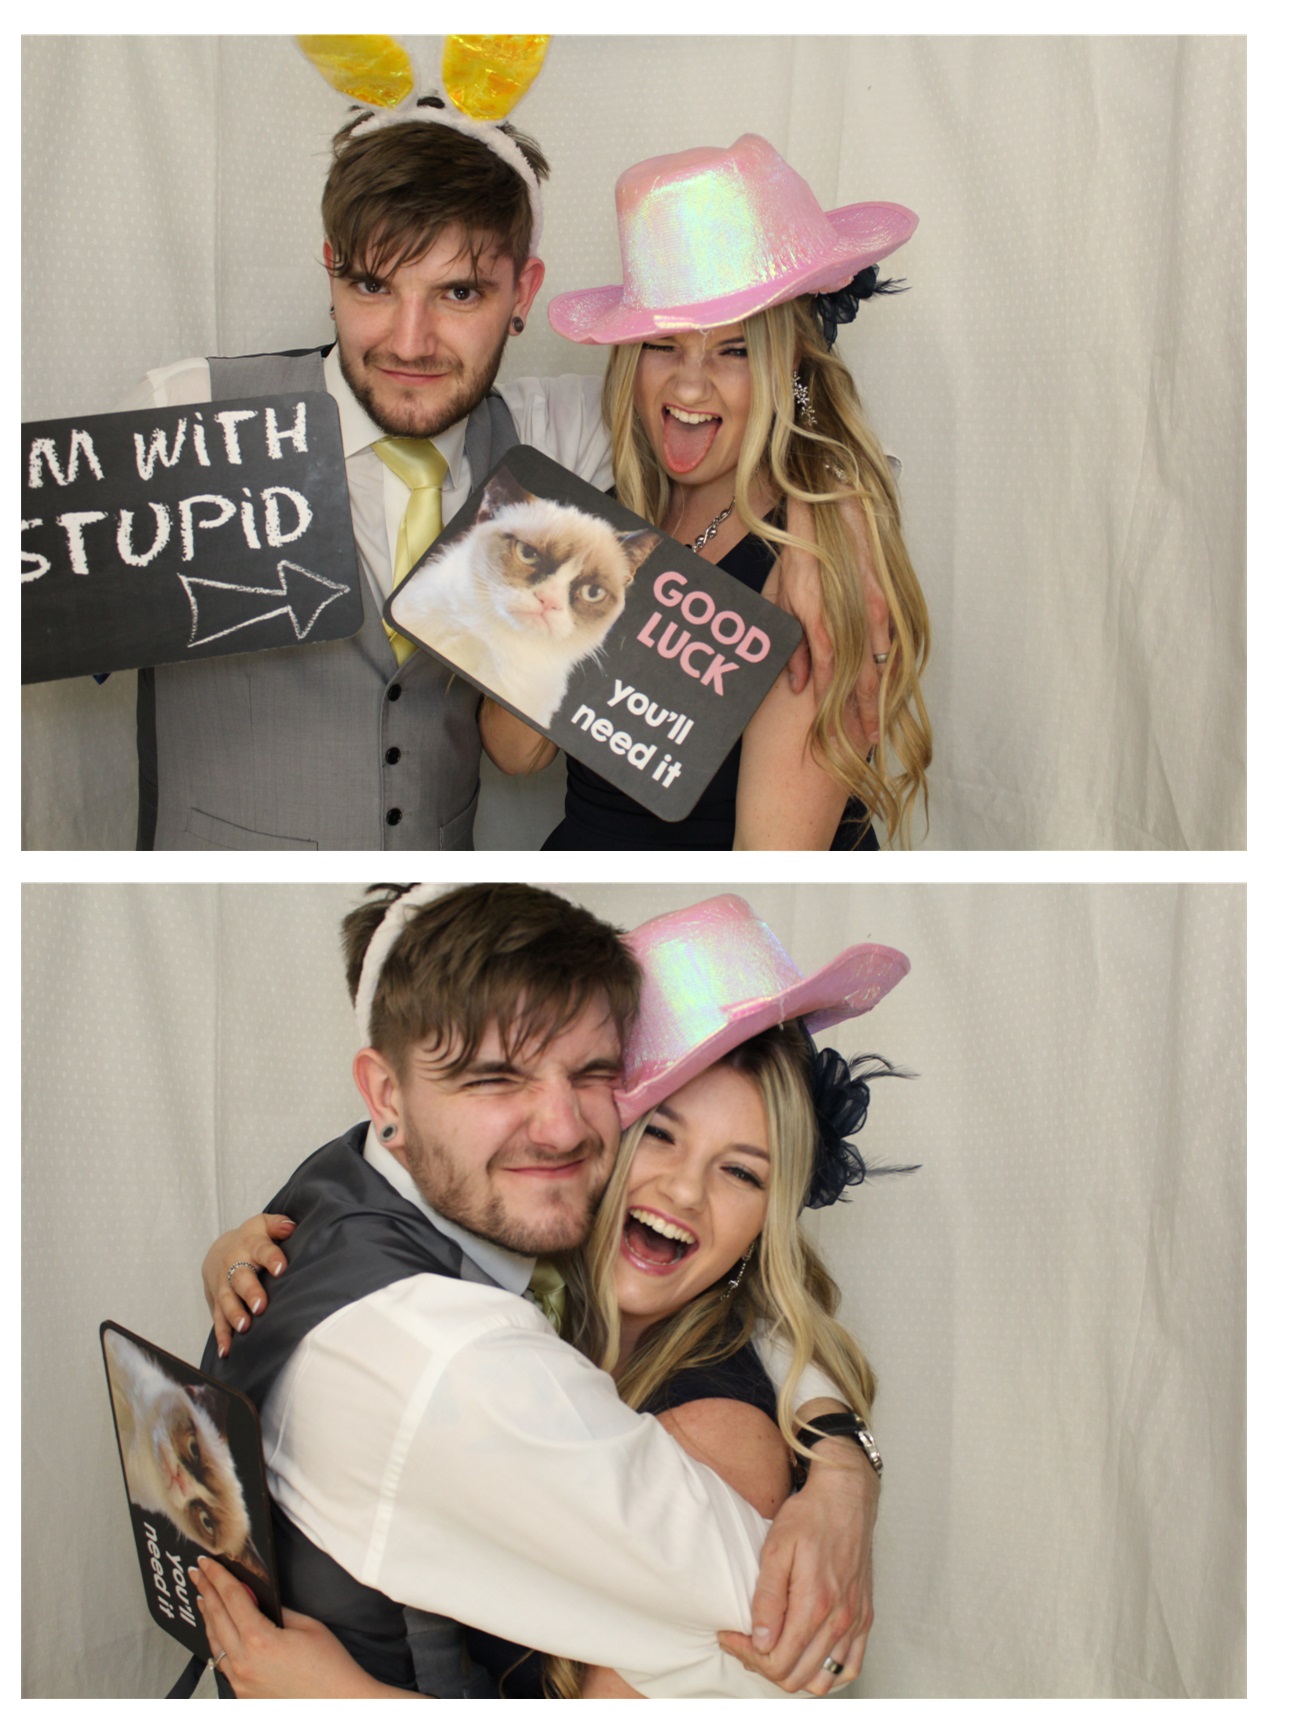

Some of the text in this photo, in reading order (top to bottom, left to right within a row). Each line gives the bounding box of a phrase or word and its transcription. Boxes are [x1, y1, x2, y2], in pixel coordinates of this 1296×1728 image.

[637, 611, 740, 696] LUCK
[653, 571, 771, 663] GOOD
[571, 704, 682, 789] need it
[607, 679, 694, 744] you'll
[143, 1521, 175, 1619] need it
[165, 1551, 196, 1628] you'll
